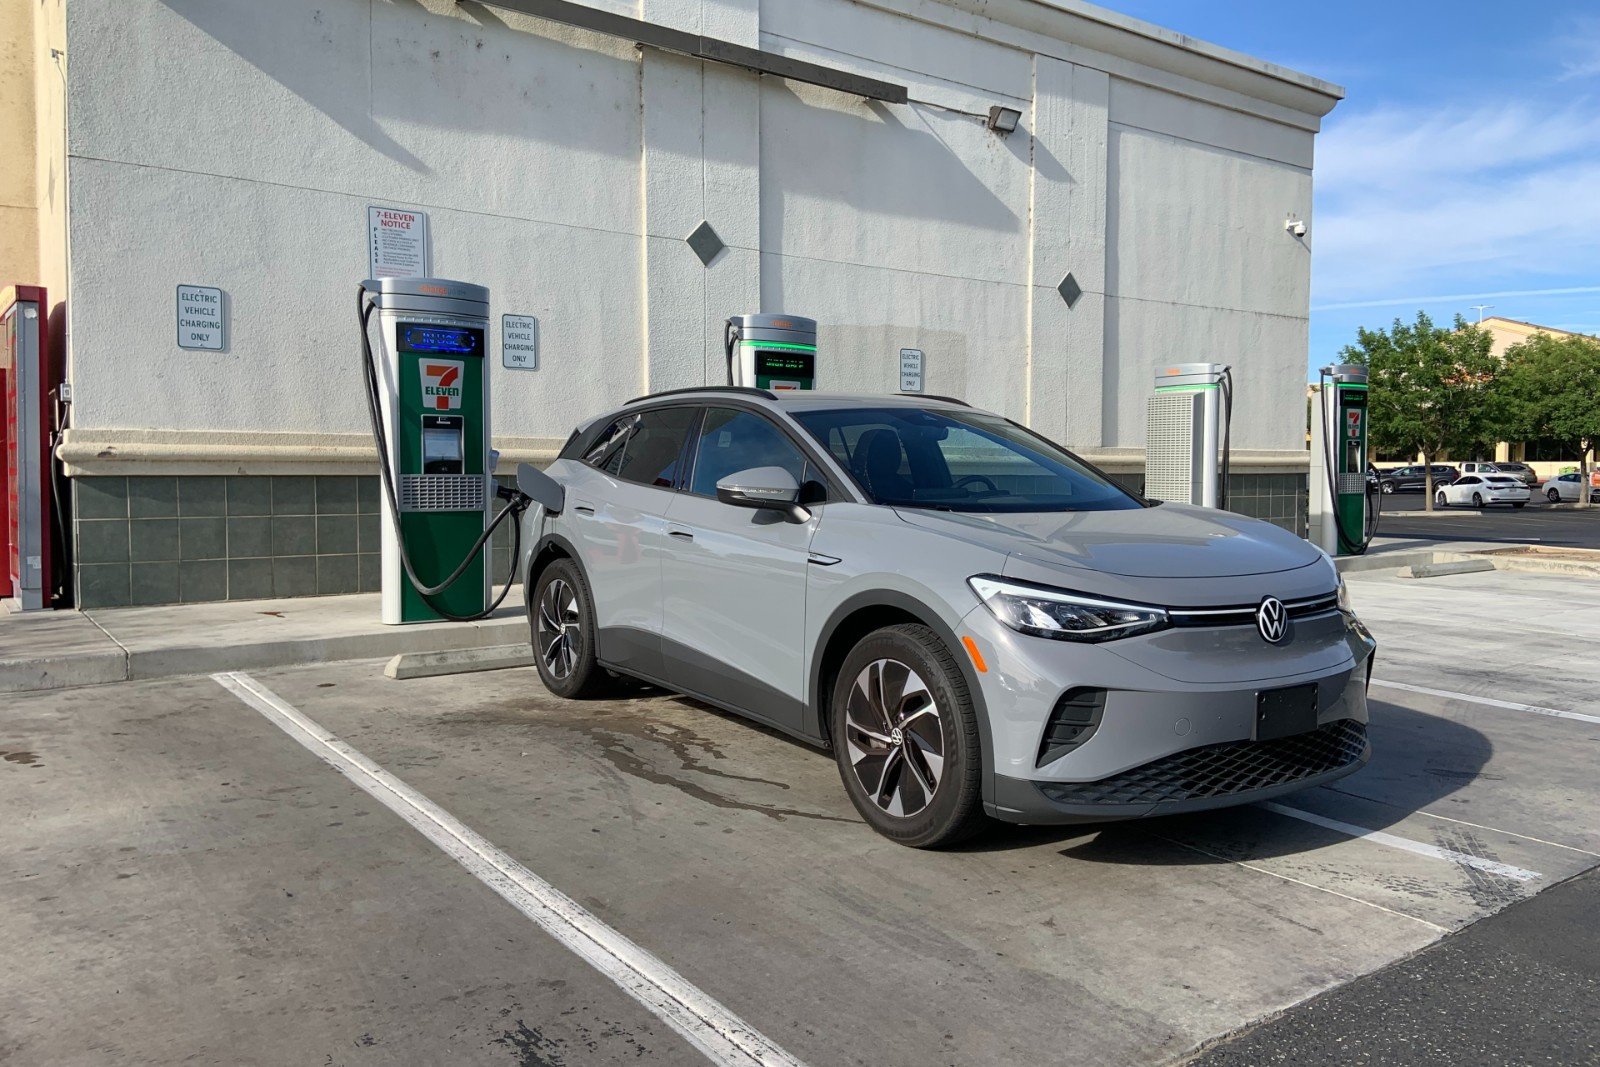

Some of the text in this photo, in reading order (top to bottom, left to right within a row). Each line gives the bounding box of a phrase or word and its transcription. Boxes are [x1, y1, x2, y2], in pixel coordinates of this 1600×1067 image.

[376, 211, 415, 222] 7-ELEVEN
[380, 219, 411, 230] NOTICE
[181, 292, 218, 304] ELECTRIC
[184, 306, 216, 317] VEHICLE
[180, 318, 220, 330] CHARGING
[505, 320, 532, 330] ELECTRIC
[190, 332, 210, 342] ONLY
[507, 332, 531, 341] VEHICLE
[504, 342, 534, 352] CHARGING
[511, 354, 527, 363] ONLY
